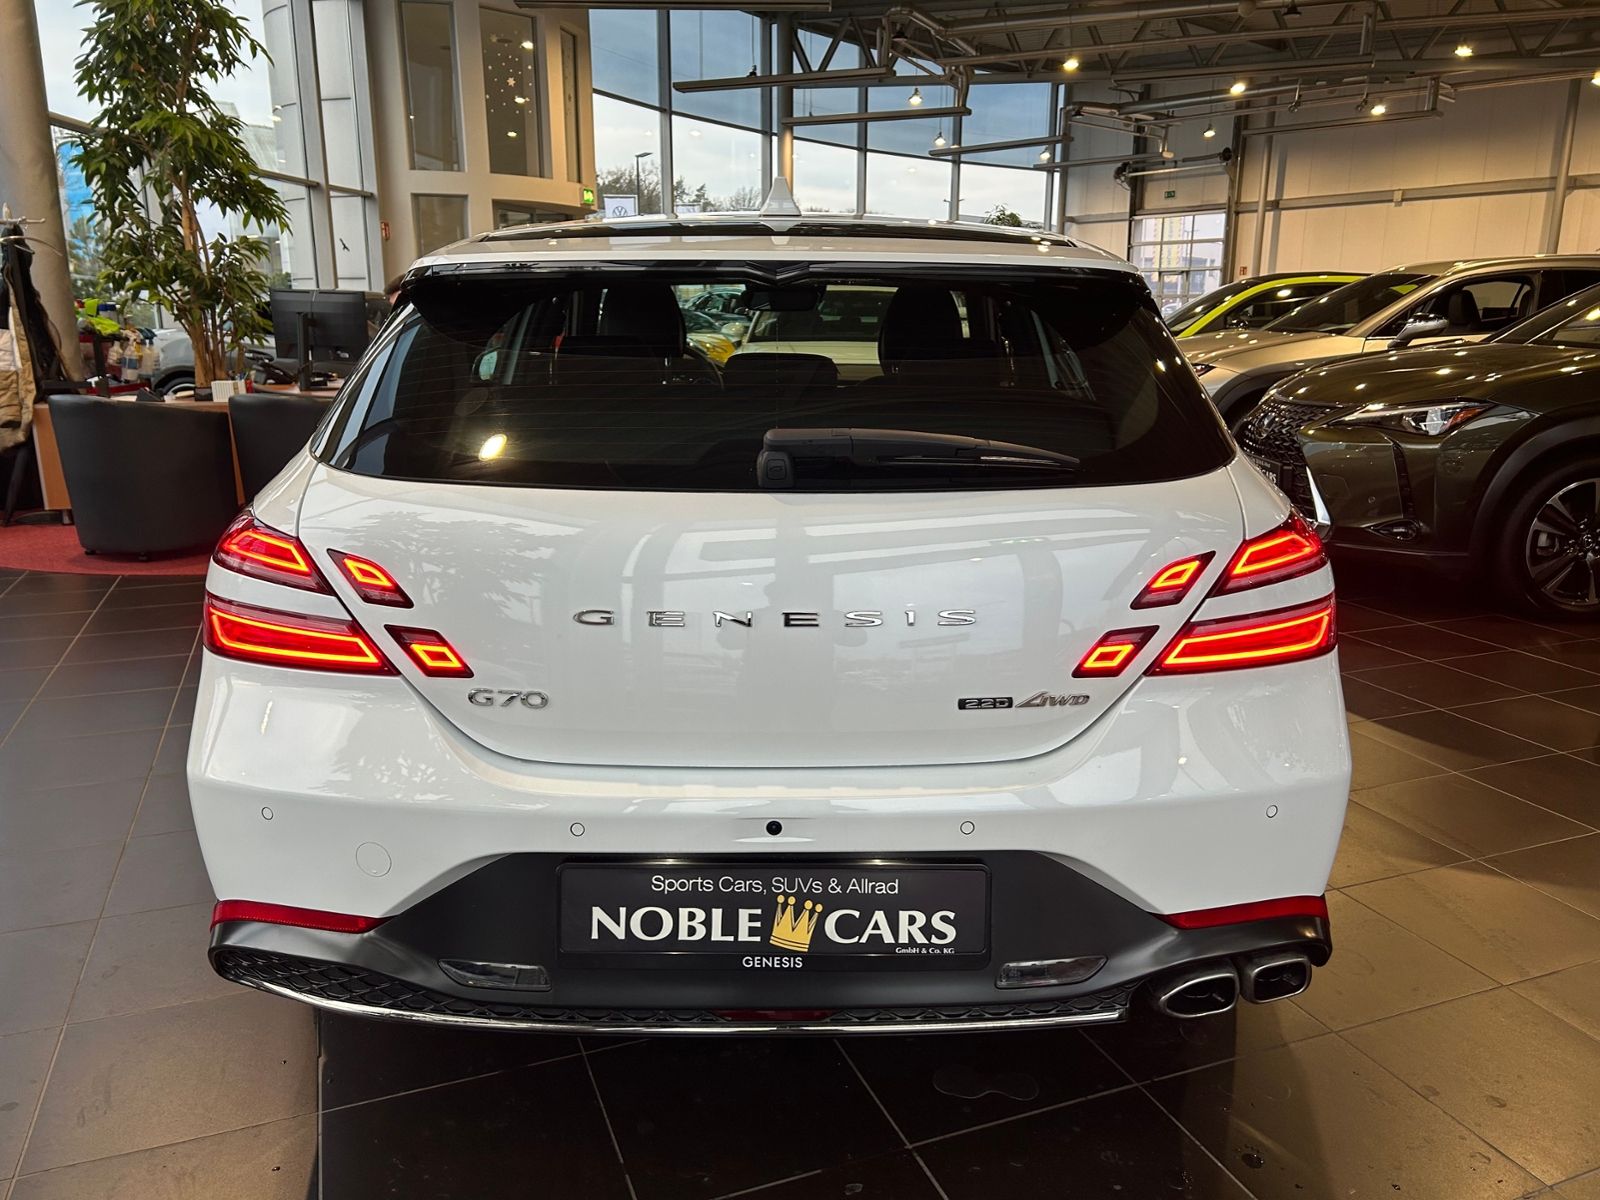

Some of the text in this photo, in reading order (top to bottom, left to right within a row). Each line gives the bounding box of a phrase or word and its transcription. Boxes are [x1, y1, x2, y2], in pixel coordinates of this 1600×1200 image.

[573, 610, 977, 628] GENESIS
[468, 687, 549, 709] G70
[651, 875, 899, 895] Sports Cars, SUVs & Allrad
[591, 906, 957, 945] NOBLE CARS
[742, 956, 803, 968] GENESIS
